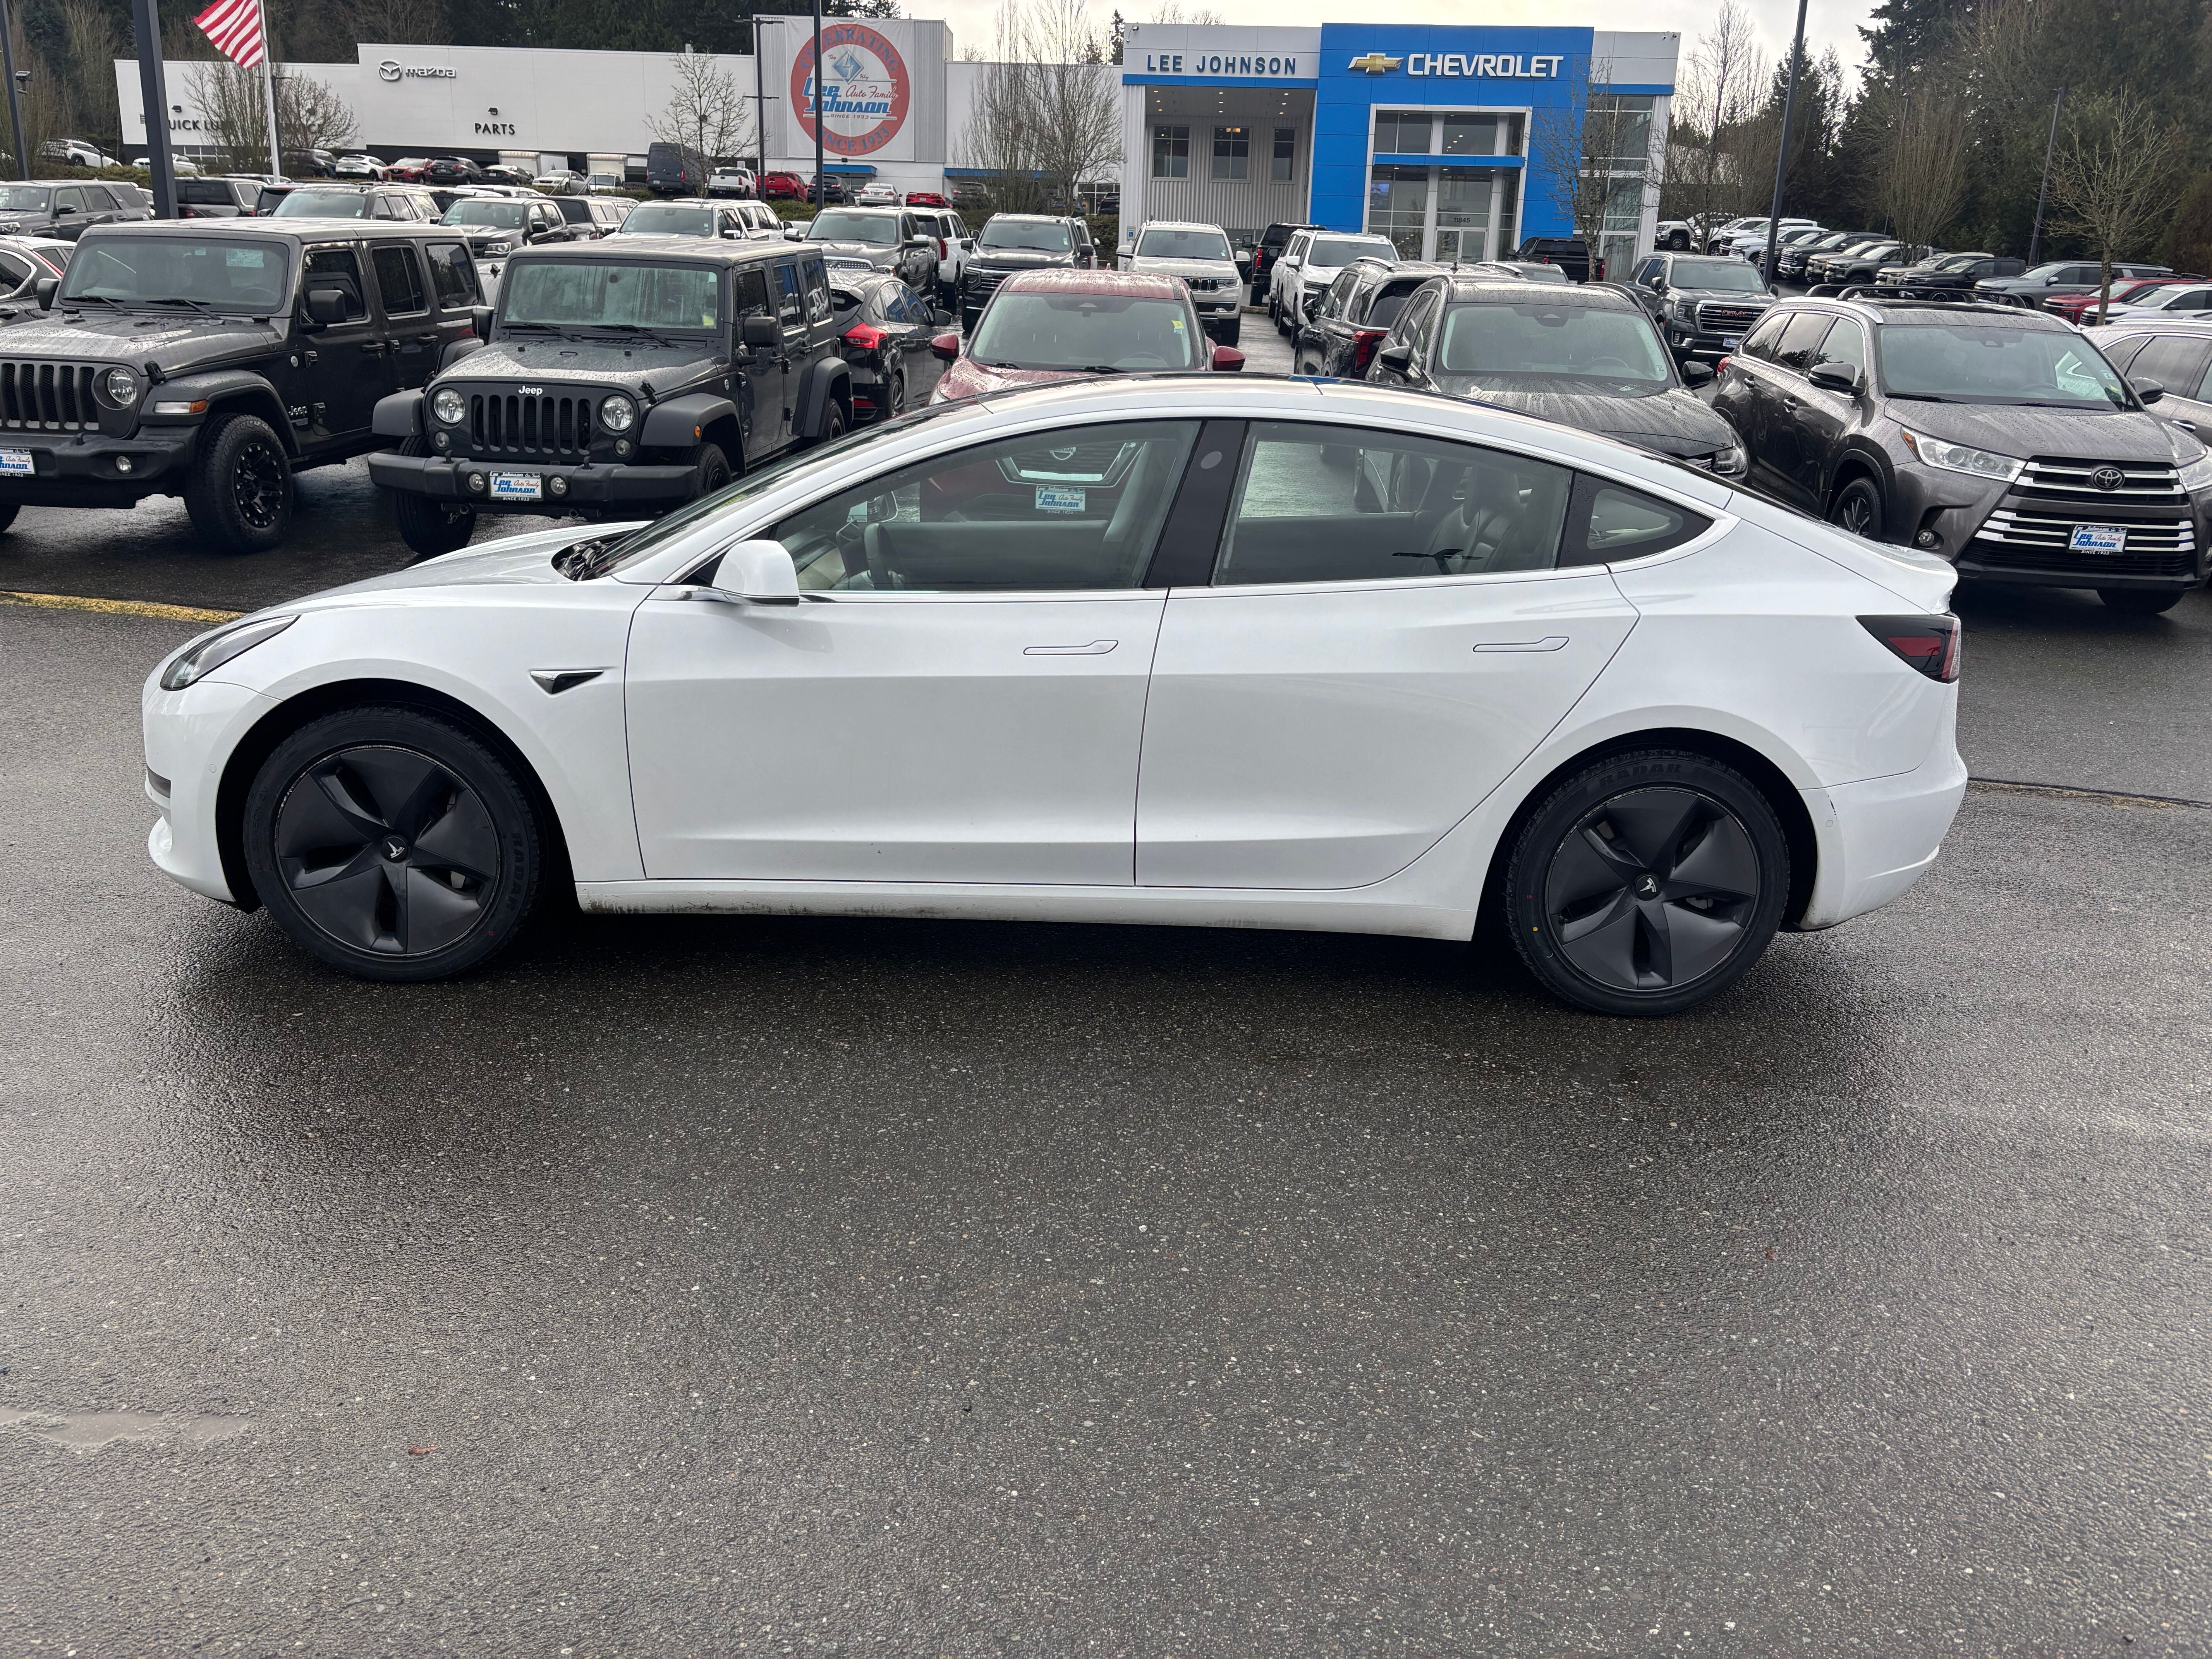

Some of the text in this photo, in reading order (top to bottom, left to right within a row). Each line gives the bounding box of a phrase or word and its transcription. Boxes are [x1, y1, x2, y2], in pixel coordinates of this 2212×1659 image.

[800, 28, 900, 71] CEEBRATING
[1147, 55, 1296, 74] LEE JOHNSON
[1408, 53, 1564, 77] CHEVROLET
[405, 67, 456, 78] mazda
[846, 85, 898, 103] Auto Family
[169, 119, 201, 131] UICK
[475, 123, 515, 135] PARTS
[862, 125, 890, 150] 1933
[519, 385, 543, 396] Jeep
[289, 406, 307, 417] Jeep
[493, 476, 512, 486] Lee
[525, 480, 539, 488] Family
[495, 484, 537, 493] Johnson
[1038, 491, 1057, 500] Lee
[1039, 499, 1080, 508] Johnson
[2073, 530, 2093, 539] Lee
[2107, 535, 2122, 543] Family
[2073, 538, 2117, 548] Johnson
[1599, 764, 1681, 787] RADAR
[259, 785, 269, 802] EV
[505, 833, 525, 912] RADAR
